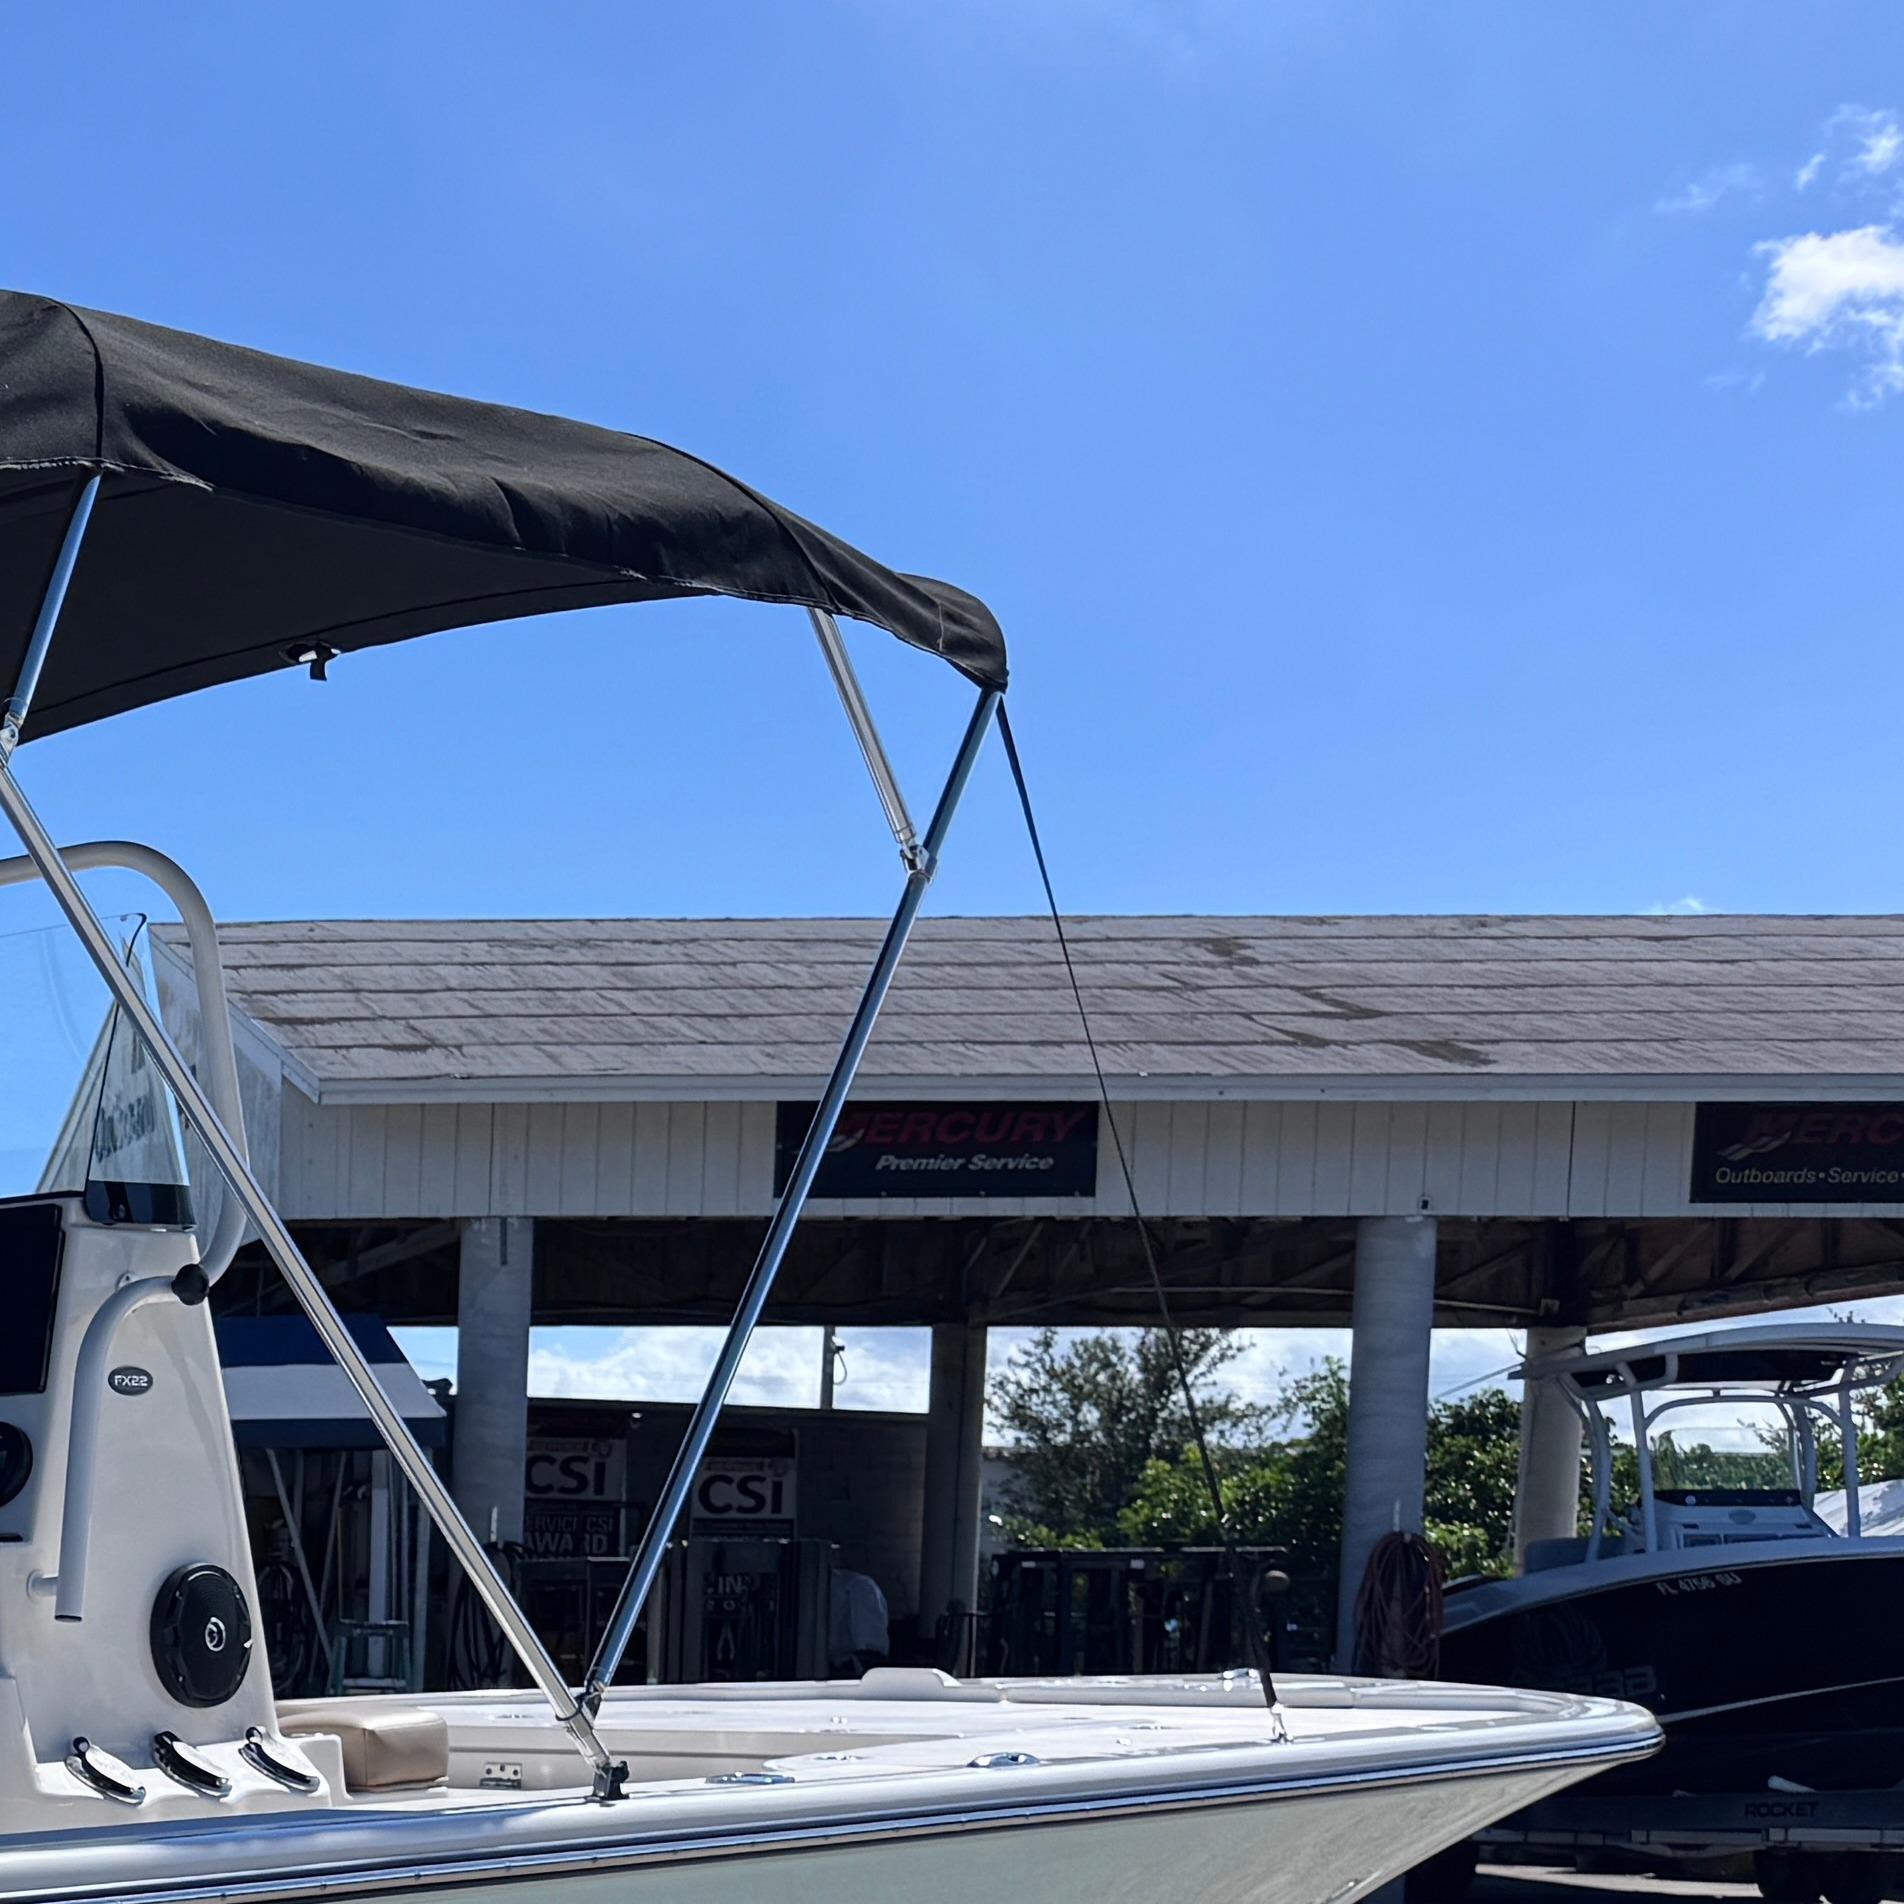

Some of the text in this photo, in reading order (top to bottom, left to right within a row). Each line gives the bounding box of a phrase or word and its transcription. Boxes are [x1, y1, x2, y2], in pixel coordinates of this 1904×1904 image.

[875, 1153, 1054, 1171] Premier Service
[113, 1374, 148, 1387] FX22
